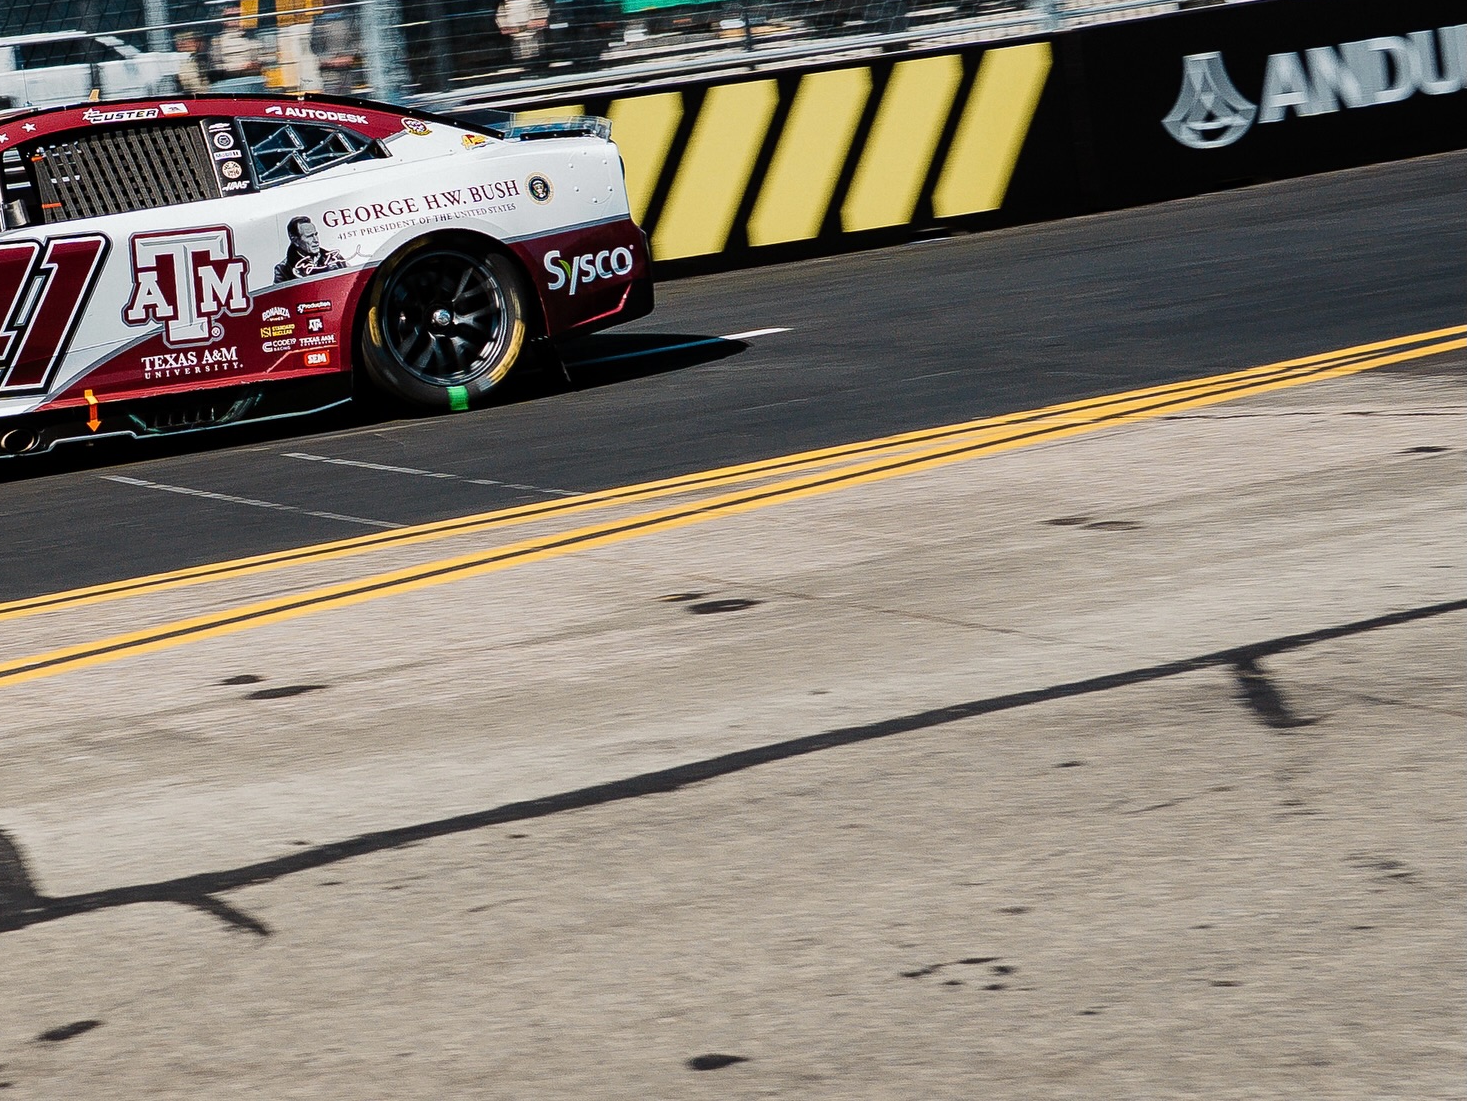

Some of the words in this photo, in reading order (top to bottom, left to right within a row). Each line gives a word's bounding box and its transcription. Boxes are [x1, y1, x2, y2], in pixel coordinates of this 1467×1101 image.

[285, 107, 369, 125] AUTODESK
[322, 197, 419, 228] GEORGE
[423, 189, 467, 211] H.W.
[467, 180, 521, 204] BUSH
[337, 230, 357, 241] 41ST
[360, 218, 417, 237] PRESIDENT
[419, 216, 432, 225] OF
[434, 211, 453, 223] THE
[454, 208, 487, 220] UNITED
[488, 203, 517, 215] STATES
[261, 306, 291, 321] BONANZA
[141, 351, 198, 372] TEXAS
[201, 346, 238, 366] A&M
[307, 353, 327, 365] SEM
